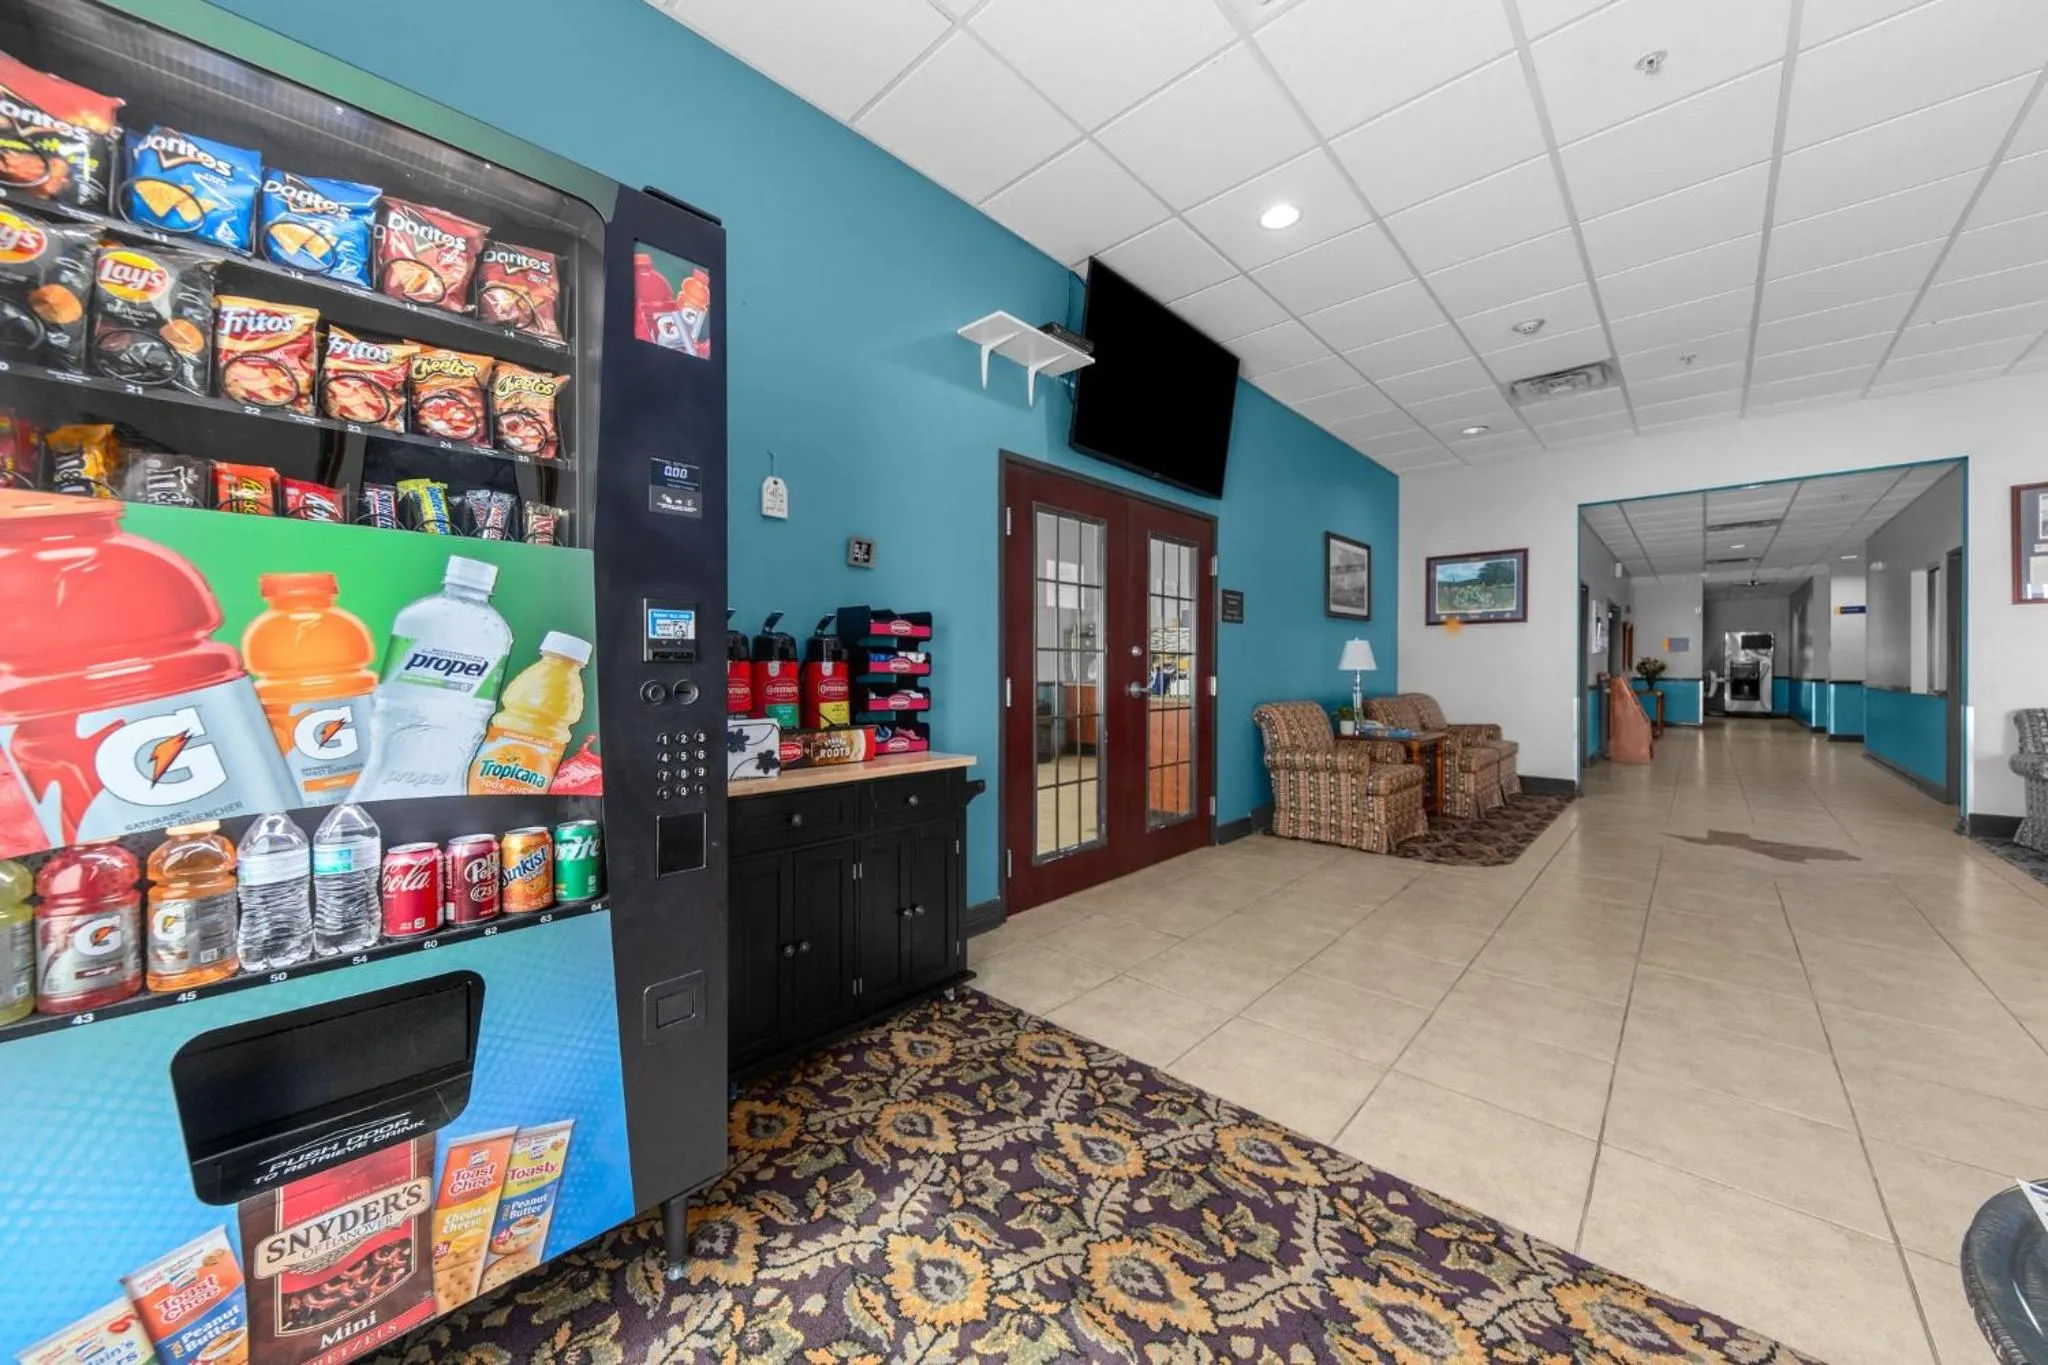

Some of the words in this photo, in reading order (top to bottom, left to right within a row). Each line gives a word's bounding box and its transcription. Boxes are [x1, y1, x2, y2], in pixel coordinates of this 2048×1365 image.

[0, 101, 89, 143] oritos
[263, 180, 352, 219] Doritos
[387, 210, 467, 251] Doritos
[483, 250, 551, 274] Doritos
[503, 330, 515, 338] 14
[413, 358, 479, 380] Cheetos
[125, 384, 143, 395] 21
[496, 376, 557, 398] Cheetos
[244, 406, 261, 416] 22
[347, 425, 361, 433] 23
[426, 486, 449, 535] Butterfinge
[404, 652, 490, 678] propel
[294, 706, 360, 760] G
[662, 735, 667, 745] 1
[681, 734, 687, 743] 2
[698, 732, 705, 742] 3
[94, 705, 229, 807] G
[661, 752, 668, 762] 4
[681, 751, 687, 761] 5
[820, 747, 850, 758] ROOTS
[479, 760, 546, 788] Tropicana
[662, 771, 669, 781] 7
[698, 767, 705, 777] 9
[383, 855, 432, 893] Cola
[502, 845, 548, 888] Sunkist
[540, 914, 553, 924] 63
[484, 926, 498, 936] 62
[424, 940, 438, 950] 60
[353, 954, 368, 965] 54
[270, 972, 288, 983] 50
[177, 991, 197, 1003] 45
[72, 1013, 94, 1025] 43
[254, 1170, 279, 1185] TO
[282, 1139, 368, 1176] RETRIEVE
[373, 1118, 426, 1143] DRINK
[269, 1142, 339, 1173] PUSH
[346, 1117, 410, 1147] DOOR
[452, 1163, 497, 1181] Toast
[509, 1161, 559, 1181] Toasty
[448, 1177, 494, 1195] Chee
[509, 1204, 543, 1220] Butter
[511, 1193, 549, 1210] Peanut
[266, 1182, 424, 1264] SNYDER'S
[302, 1244, 322, 1261] OF
[323, 1214, 395, 1252] HANOVER
[156, 1274, 220, 1312] Toast
[161, 1286, 222, 1324] Chee
[180, 1304, 242, 1344] Peanut
[184, 1317, 240, 1353] Butter
[319, 1310, 377, 1350] Mini
[310, 1322, 399, 1365] RETZELS
